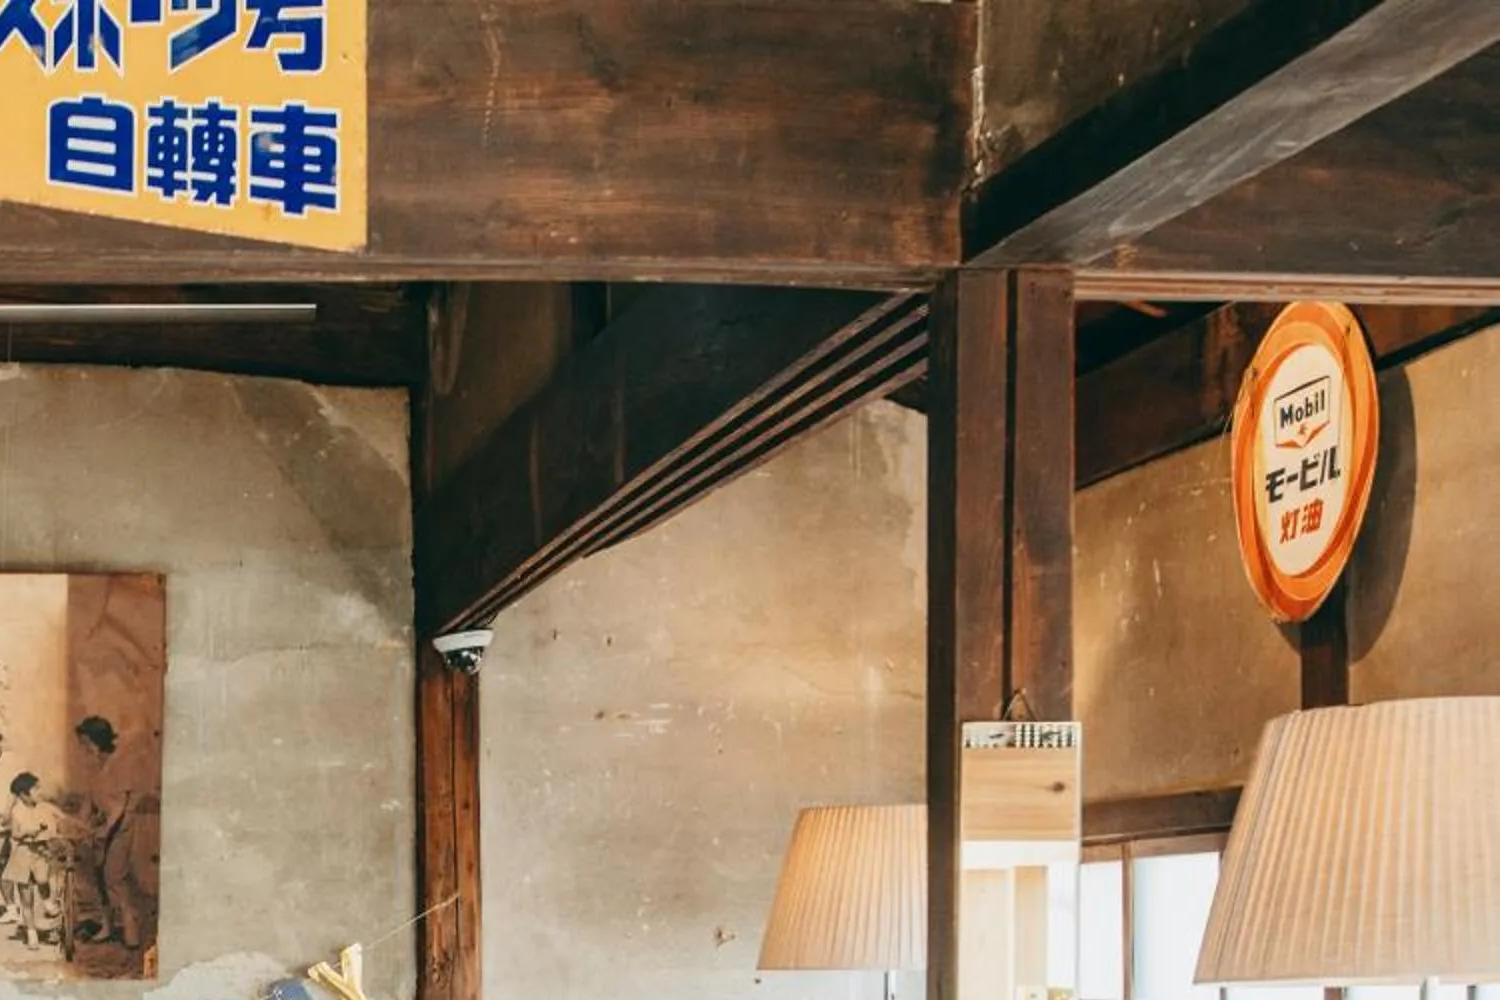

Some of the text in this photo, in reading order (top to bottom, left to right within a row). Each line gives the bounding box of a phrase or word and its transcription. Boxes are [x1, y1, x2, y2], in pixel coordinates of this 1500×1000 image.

[48, 97, 339, 215] 自轉車
[1279, 388, 1325, 429] Mobil
[1265, 446, 1341, 504] モービル
[1279, 498, 1325, 545] 灯油
